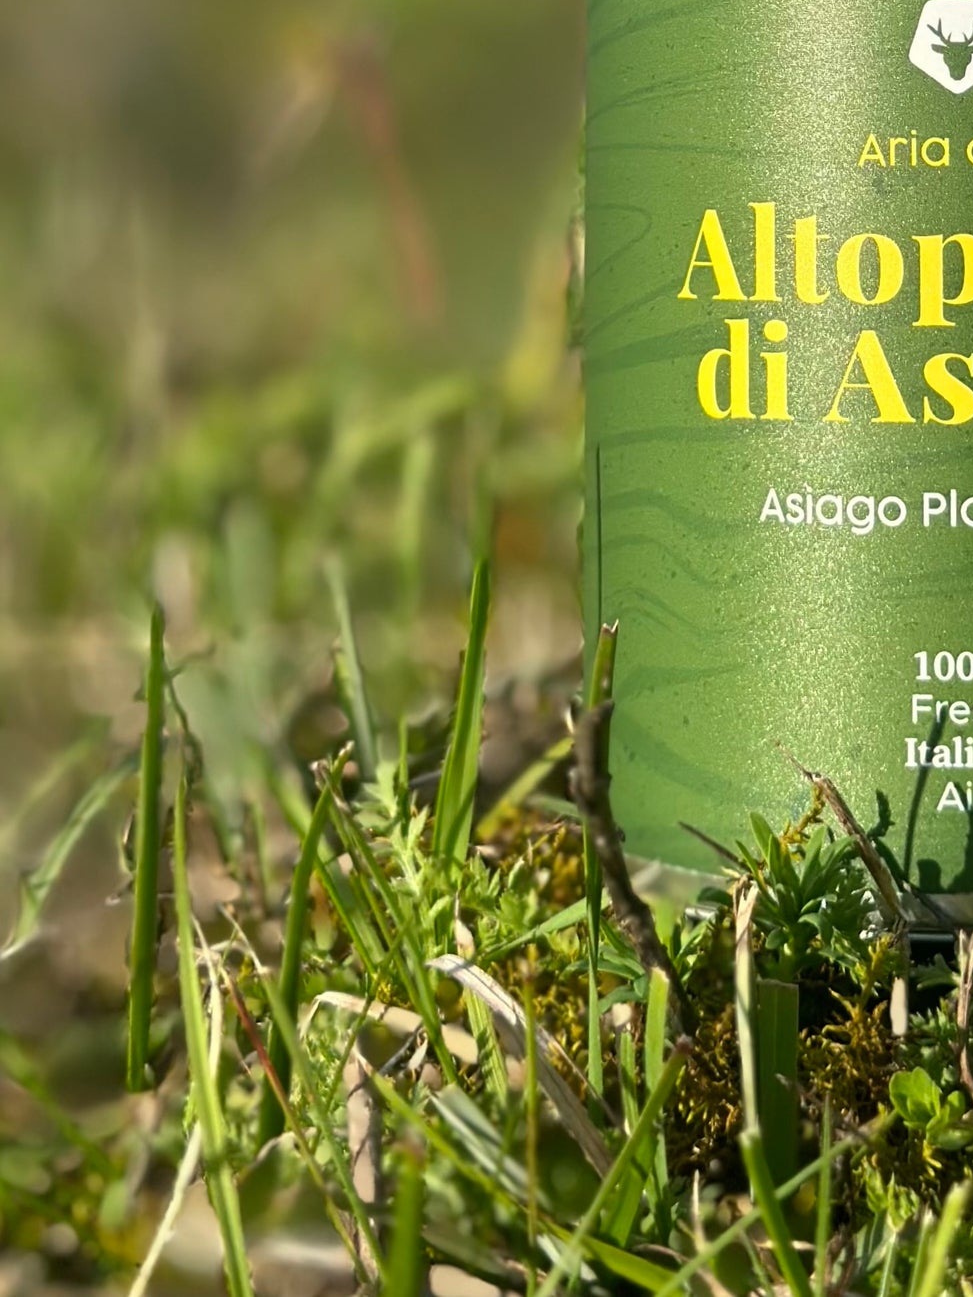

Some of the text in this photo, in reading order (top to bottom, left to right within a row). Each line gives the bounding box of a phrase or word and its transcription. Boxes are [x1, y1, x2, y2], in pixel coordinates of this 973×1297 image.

[858, 129, 950, 168] Aria
[697, 318, 795, 420] di
[760, 485, 907, 534] Asiago
